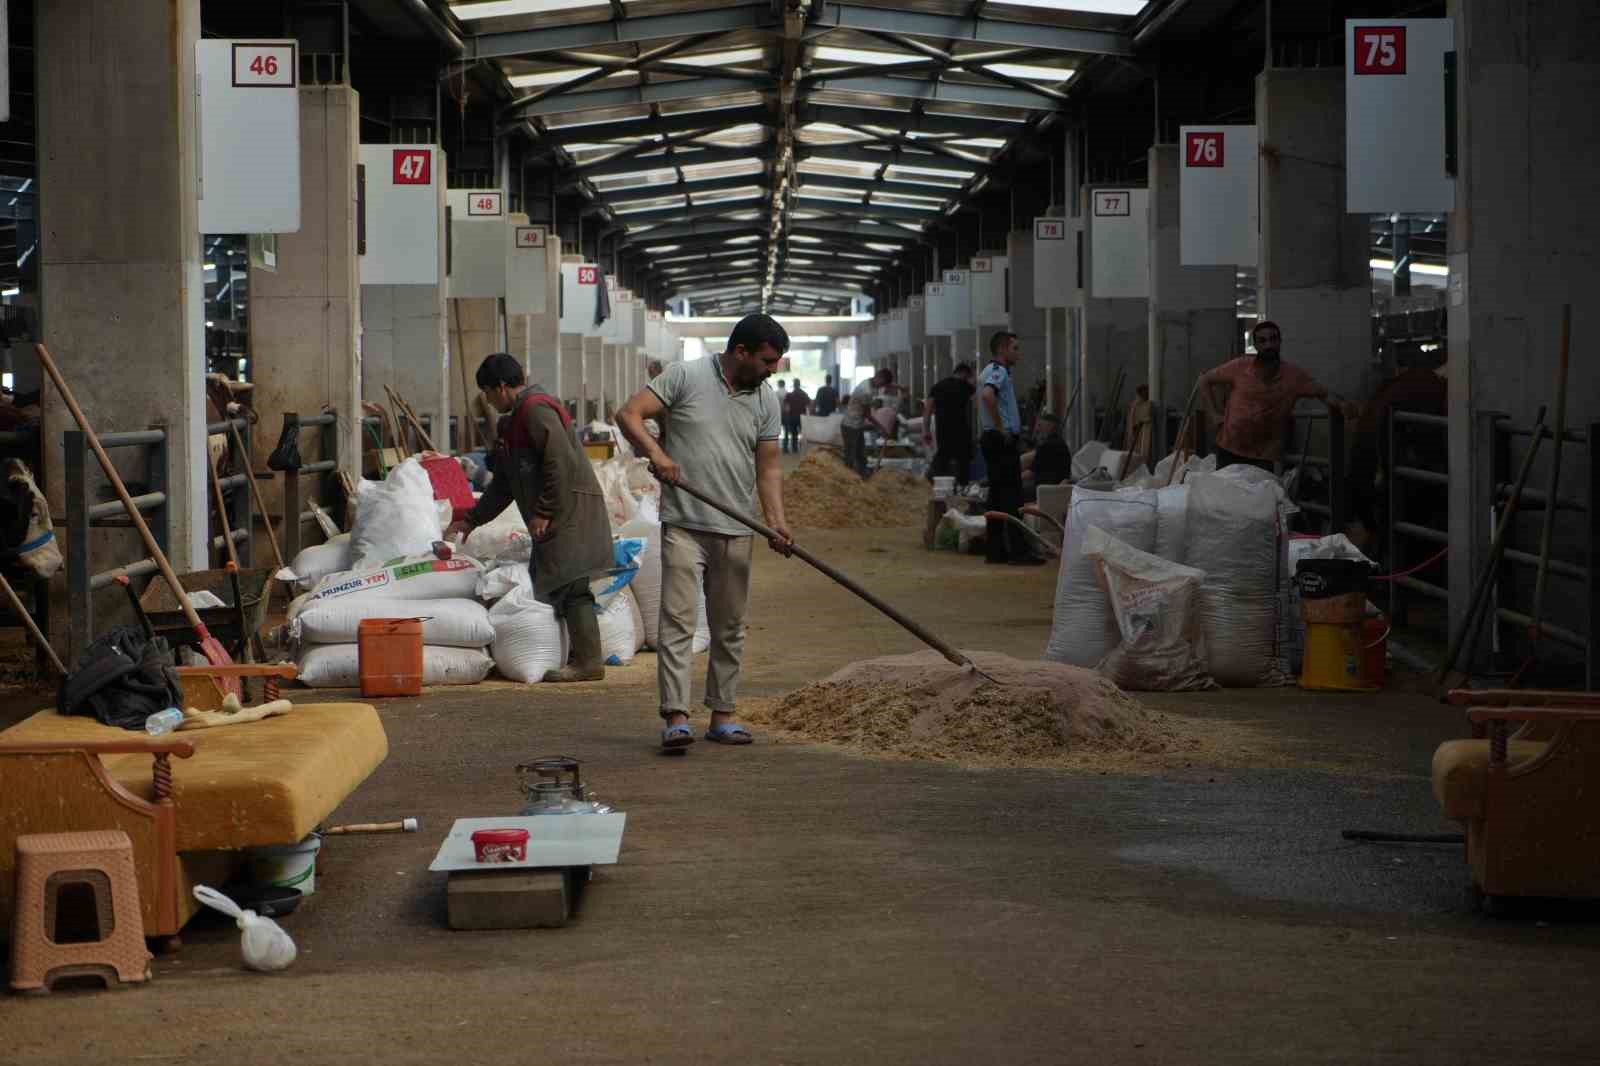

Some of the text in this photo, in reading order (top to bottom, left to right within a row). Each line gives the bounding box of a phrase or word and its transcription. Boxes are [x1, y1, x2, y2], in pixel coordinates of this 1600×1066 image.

[1363, 34, 1397, 67] 75
[249, 55, 278, 76] 46
[1191, 138, 1217, 163] 76
[400, 156, 425, 179] 47
[477, 198, 493, 210] 48
[1103, 198, 1121, 209] 77
[524, 231, 538, 243] 49
[1043, 224, 1057, 236] 78
[581, 267, 595, 282] 50
[321, 579, 364, 598] MUNZUR
[366, 573, 386, 586] YEM
